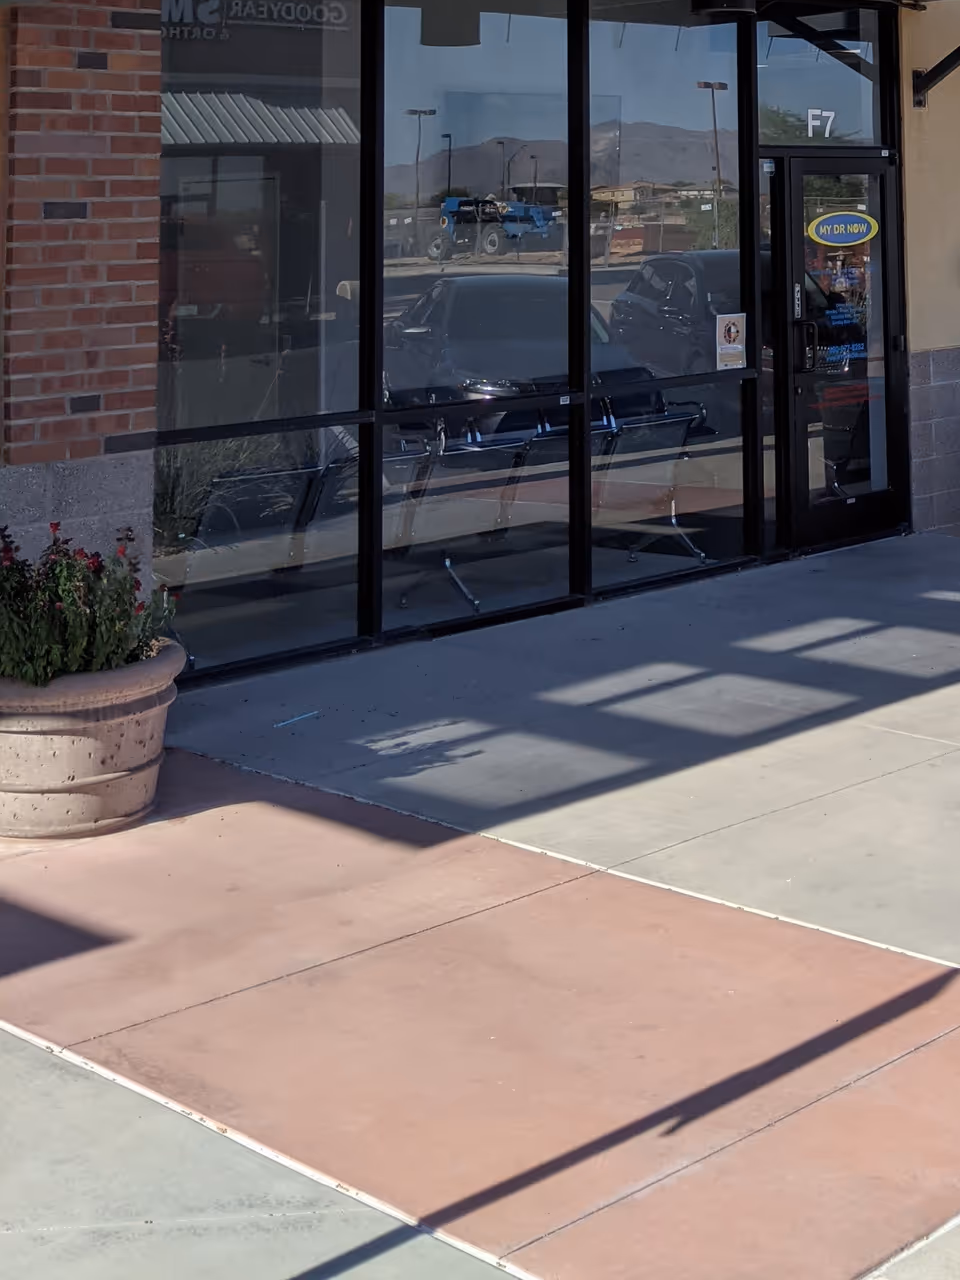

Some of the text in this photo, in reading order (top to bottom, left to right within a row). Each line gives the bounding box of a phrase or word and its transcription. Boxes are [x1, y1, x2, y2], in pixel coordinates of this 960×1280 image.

[807, 108, 835, 138] F7
[819, 223, 867, 235] MY DR NOW
